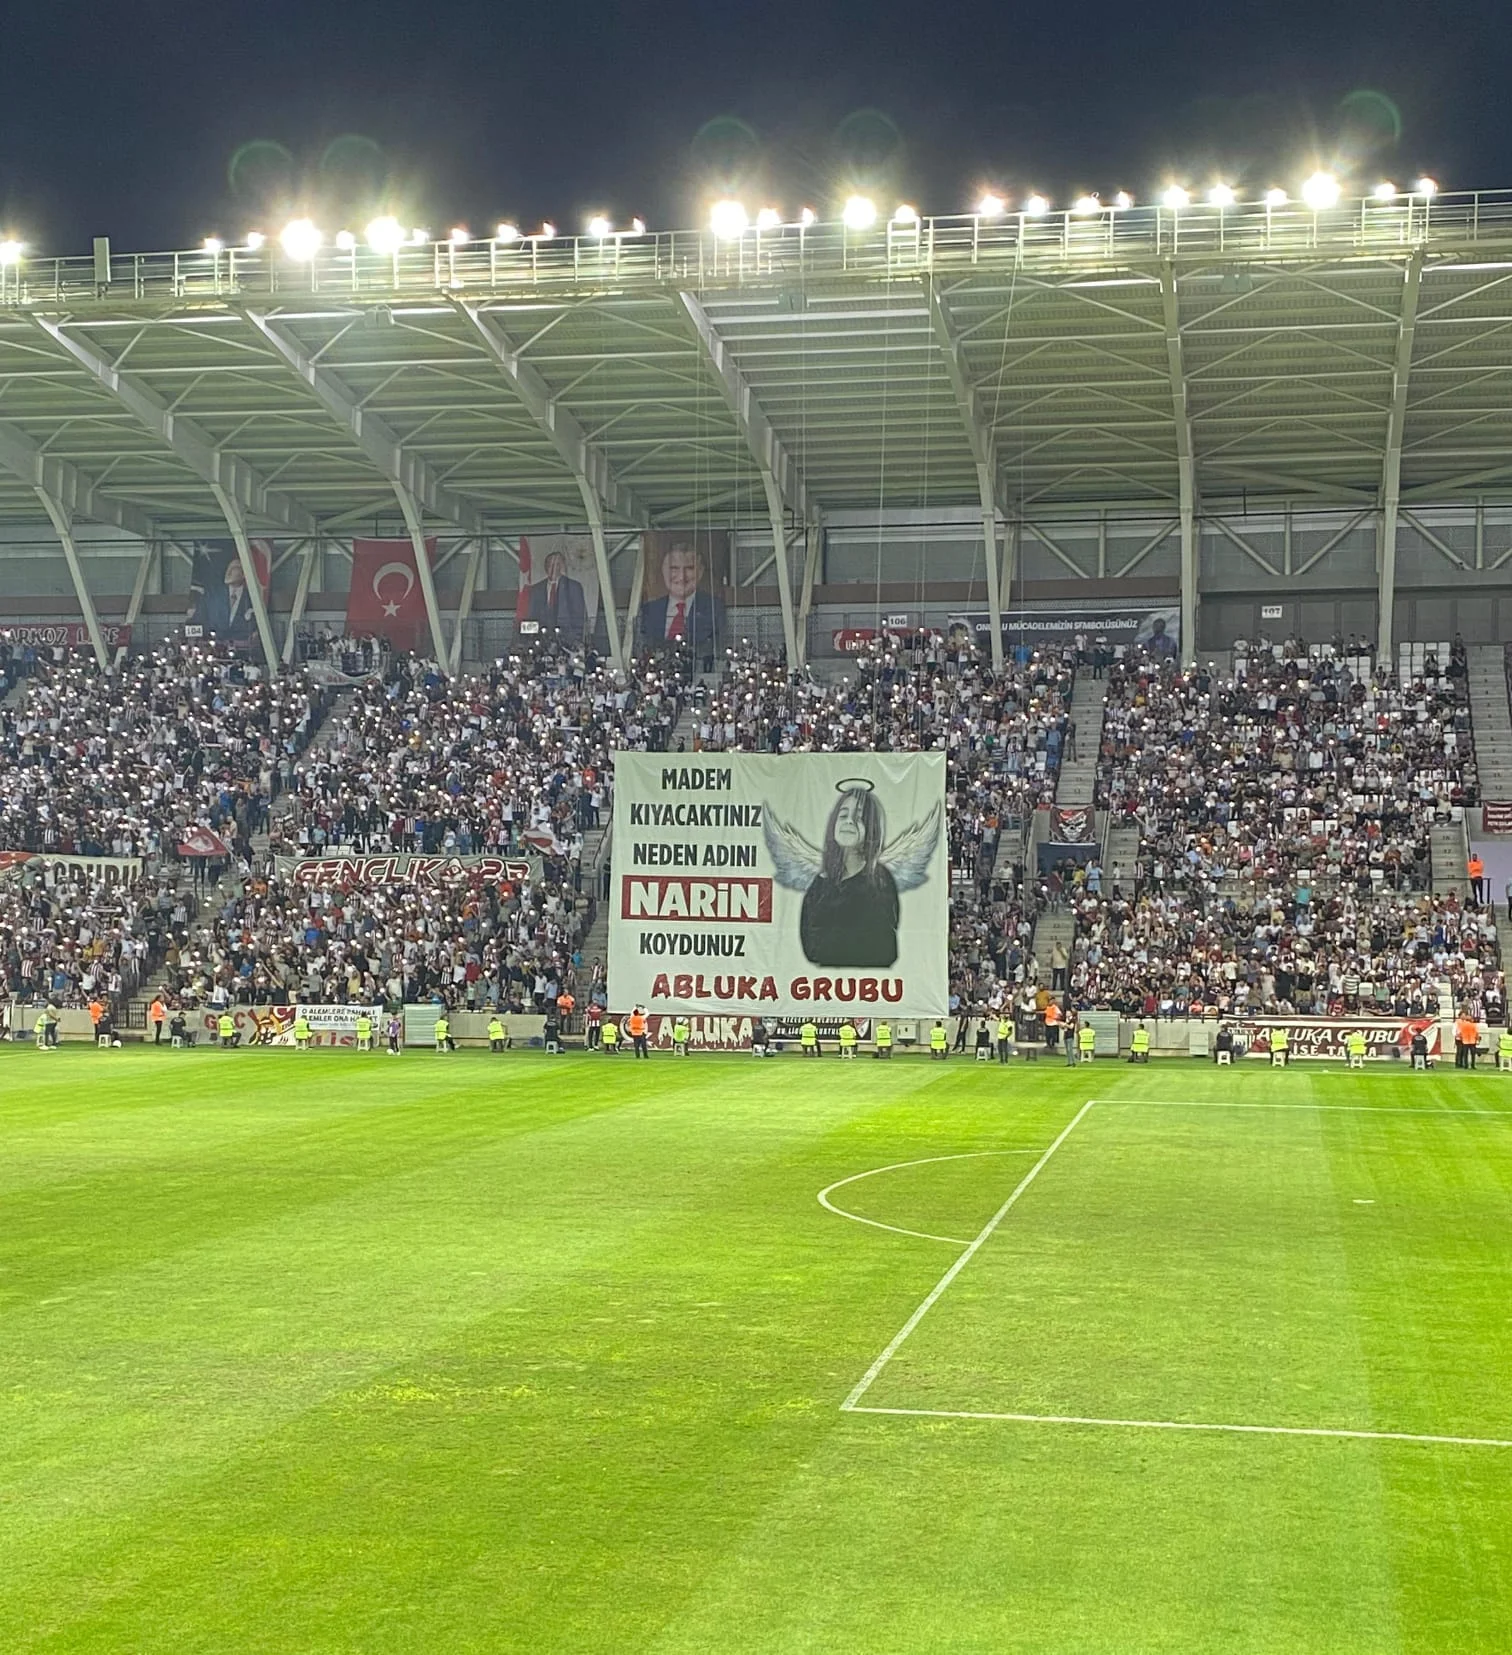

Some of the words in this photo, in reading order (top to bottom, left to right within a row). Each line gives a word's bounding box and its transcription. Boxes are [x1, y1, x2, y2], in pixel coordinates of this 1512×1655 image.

[661, 768, 732, 790] MADEM
[630, 803, 762, 827] KIYACAKTINIZ
[633, 843, 698, 866] NEDEN
[702, 844, 757, 867] ADINI
[640, 933, 745, 957] KOYDUNUZ
[651, 973, 779, 1002] ABLUKA
[790, 976, 904, 1003] GRUBU
[658, 1017, 753, 1048] ALUKA
[1337, 1029, 1401, 1044] GUBU
[1293, 1043, 1319, 1056] İSE
[1326, 1045, 1377, 1057] TAA
